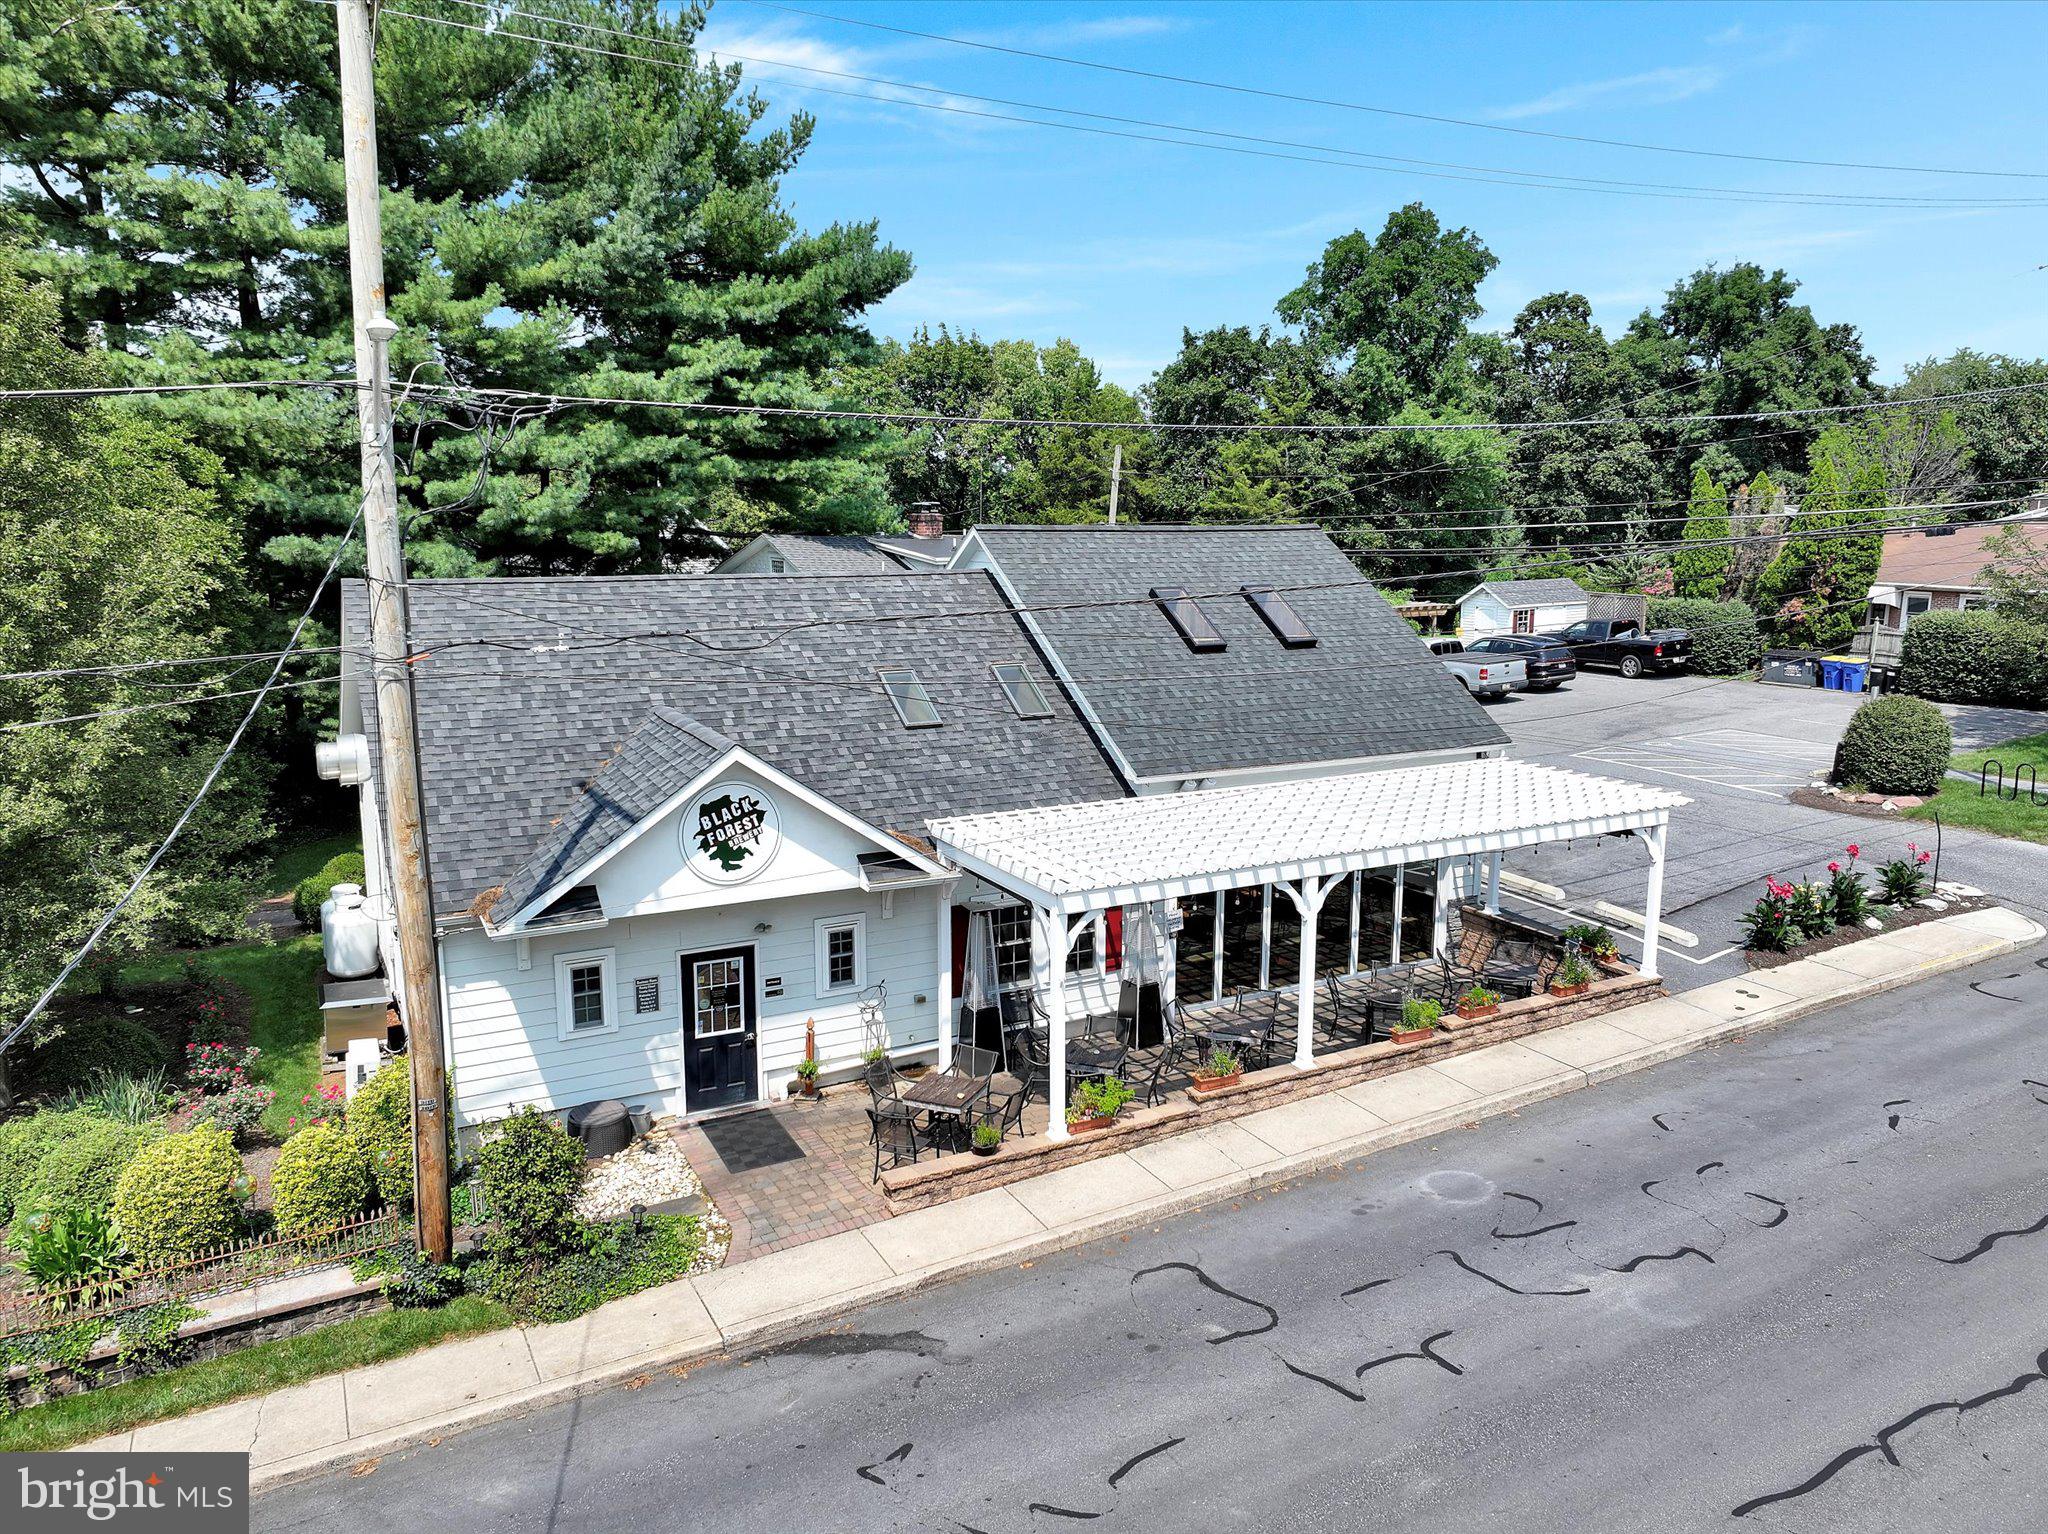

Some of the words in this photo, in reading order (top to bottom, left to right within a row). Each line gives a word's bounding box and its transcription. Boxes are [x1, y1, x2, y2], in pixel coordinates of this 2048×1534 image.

[700, 797, 753, 830] BLACK
[706, 813, 760, 846] FOREST
[728, 827, 763, 848] BREWERY
